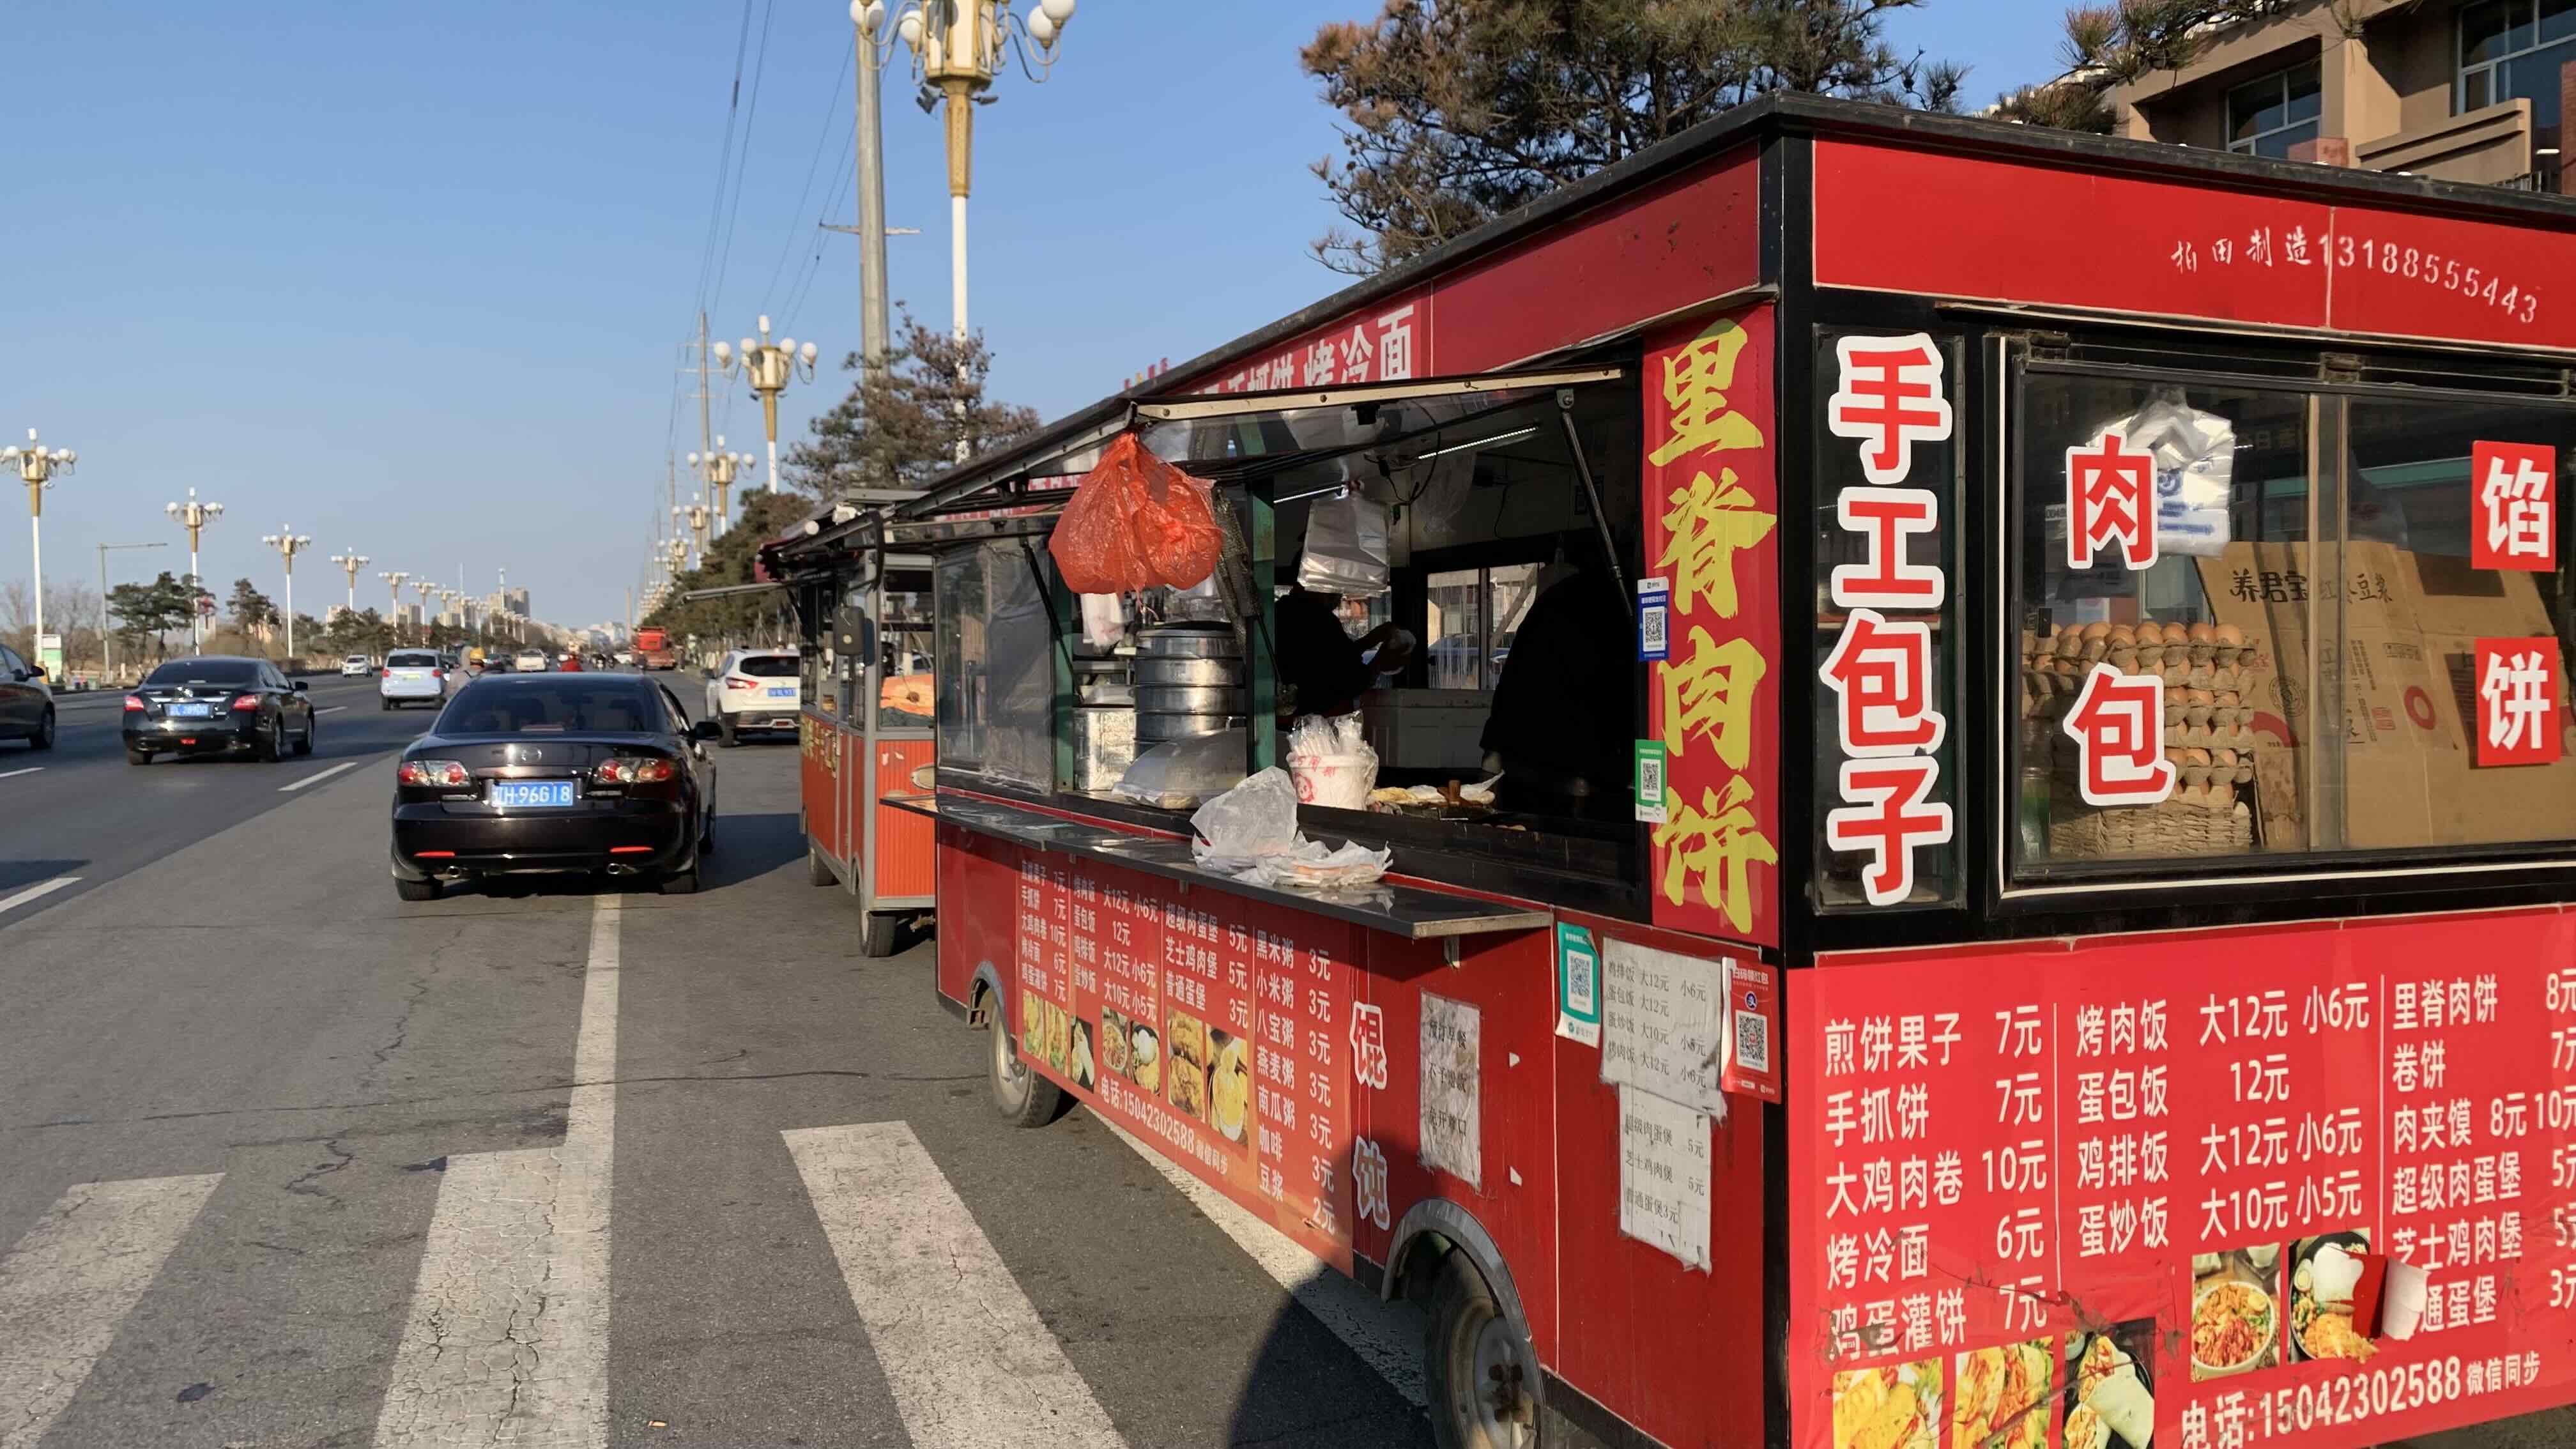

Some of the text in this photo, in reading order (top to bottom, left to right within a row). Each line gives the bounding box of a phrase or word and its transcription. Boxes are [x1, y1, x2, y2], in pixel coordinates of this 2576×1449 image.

[1648, 318, 1778, 935] 里脊肉饼
[1824, 337, 1949, 901] 手工包子
[2067, 431, 2173, 801] 肉包
[2481, 456, 2551, 751] 馅饼
[1054, 871, 1066, 893] 7元
[1054, 898, 1066, 920] 7元
[1104, 884, 1130, 914] 大12元
[1134, 893, 1158, 923] 小6元
[1050, 924, 1066, 947] 10元
[1073, 904, 1130, 946] 蛋包饭 12元
[1165, 902, 1248, 953] 超级肉蛋堡 5元
[1054, 952, 1066, 975] 6元
[1104, 946, 1130, 978] 大12元
[1132, 957, 1156, 989] 小6元
[1165, 935, 1248, 991] 芝士鸡肉堡 5元
[1257, 930, 1331, 981] 黑米粥 3元
[1054, 979, 1066, 1002] 7元
[1103, 977, 1130, 1011] 大10元
[1132, 990, 1157, 1022] 小5元
[1165, 969, 1248, 1029] 普通蛋堡 3元
[1257, 968, 1331, 1023] 小米粥 3元
[1640, 970, 1669, 992] 大12元
[1681, 979, 1706, 1002] 小6元
[1641, 993, 1669, 1017] 大12元
[2393, 969, 2576, 1031] 里脊肉饼 8元
[1257, 1008, 1331, 1066] 八宝粥 3元
[1641, 1022, 1669, 1045] 大10元
[1825, 1005, 2042, 1077] 煎饼果子 7元
[2076, 982, 2370, 1057] 烤肉饭 大12元 小6元
[1257, 1045, 1331, 1108] 燕麦粥 3元
[1641, 1051, 1669, 1076] 大12元
[1681, 1064, 1706, 1087] 小6元
[2077, 1054, 2289, 1124] 蛋包饭 12元
[2392, 1039, 2446, 1092] 卷饼
[1257, 1084, 1332, 1151] 南瓜粥 3元
[1825, 1072, 2043, 1147] 手抓饼 7元
[2394, 1098, 2472, 1154] 肉夹馍
[2490, 1092, 2527, 1140] 8元
[1259, 1124, 1335, 1193] 咖啡 3元
[1687, 1139, 1704, 1158] 5元
[2077, 1107, 2363, 1190] 鸡排饭 大12元 小6元
[1259, 1162, 1335, 1236] 豆浆 2元
[1688, 1177, 1705, 1196] 5元
[1826, 1140, 2047, 1220] 大鸡肉卷 10元
[2392, 1151, 2522, 1215] 超级肉蛋堡
[2078, 1170, 2362, 1257] 蛋炒饭 大10元 小5元
[2392, 1211, 2523, 1273] 芝士鸡肉堡
[1827, 1208, 2044, 1291] 烤冷面 6元
[1829, 1276, 2047, 1361] 鸡蛋灌饼 7元
[2420, 1275, 2497, 1333] 通蛋堡
[2466, 1350, 2541, 1396] 微信同步
